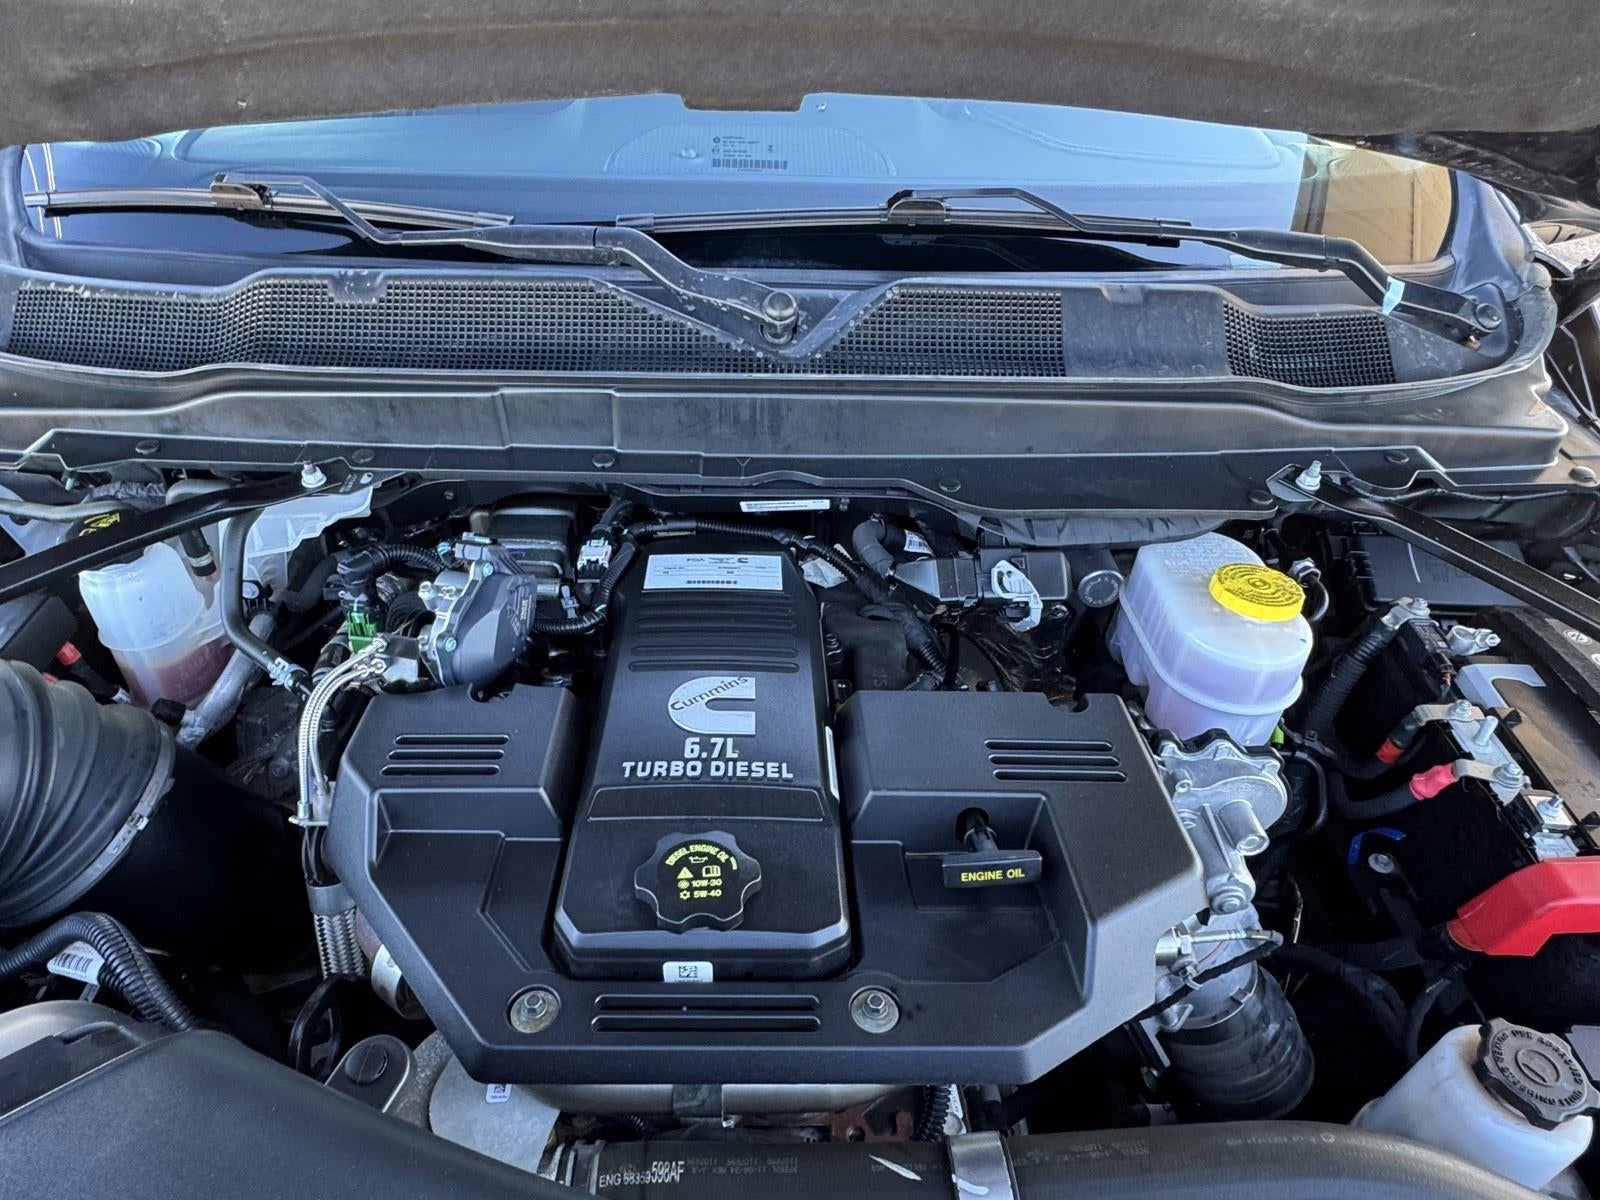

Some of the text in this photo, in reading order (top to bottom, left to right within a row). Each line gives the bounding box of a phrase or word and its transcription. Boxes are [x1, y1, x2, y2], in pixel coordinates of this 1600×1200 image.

[669, 676, 748, 712] Cummins
[684, 737, 739, 759] 6.7L
[622, 761, 794, 779] TURBO DIESEL
[665, 847, 690, 866] DIESEL
[690, 845, 720, 855] ENGINE
[961, 867, 1025, 881] ENGINE OIL
[692, 879, 722, 887] 10W-30
[694, 889, 722, 898] 5W-40
[599, 1174, 622, 1188] ENG
